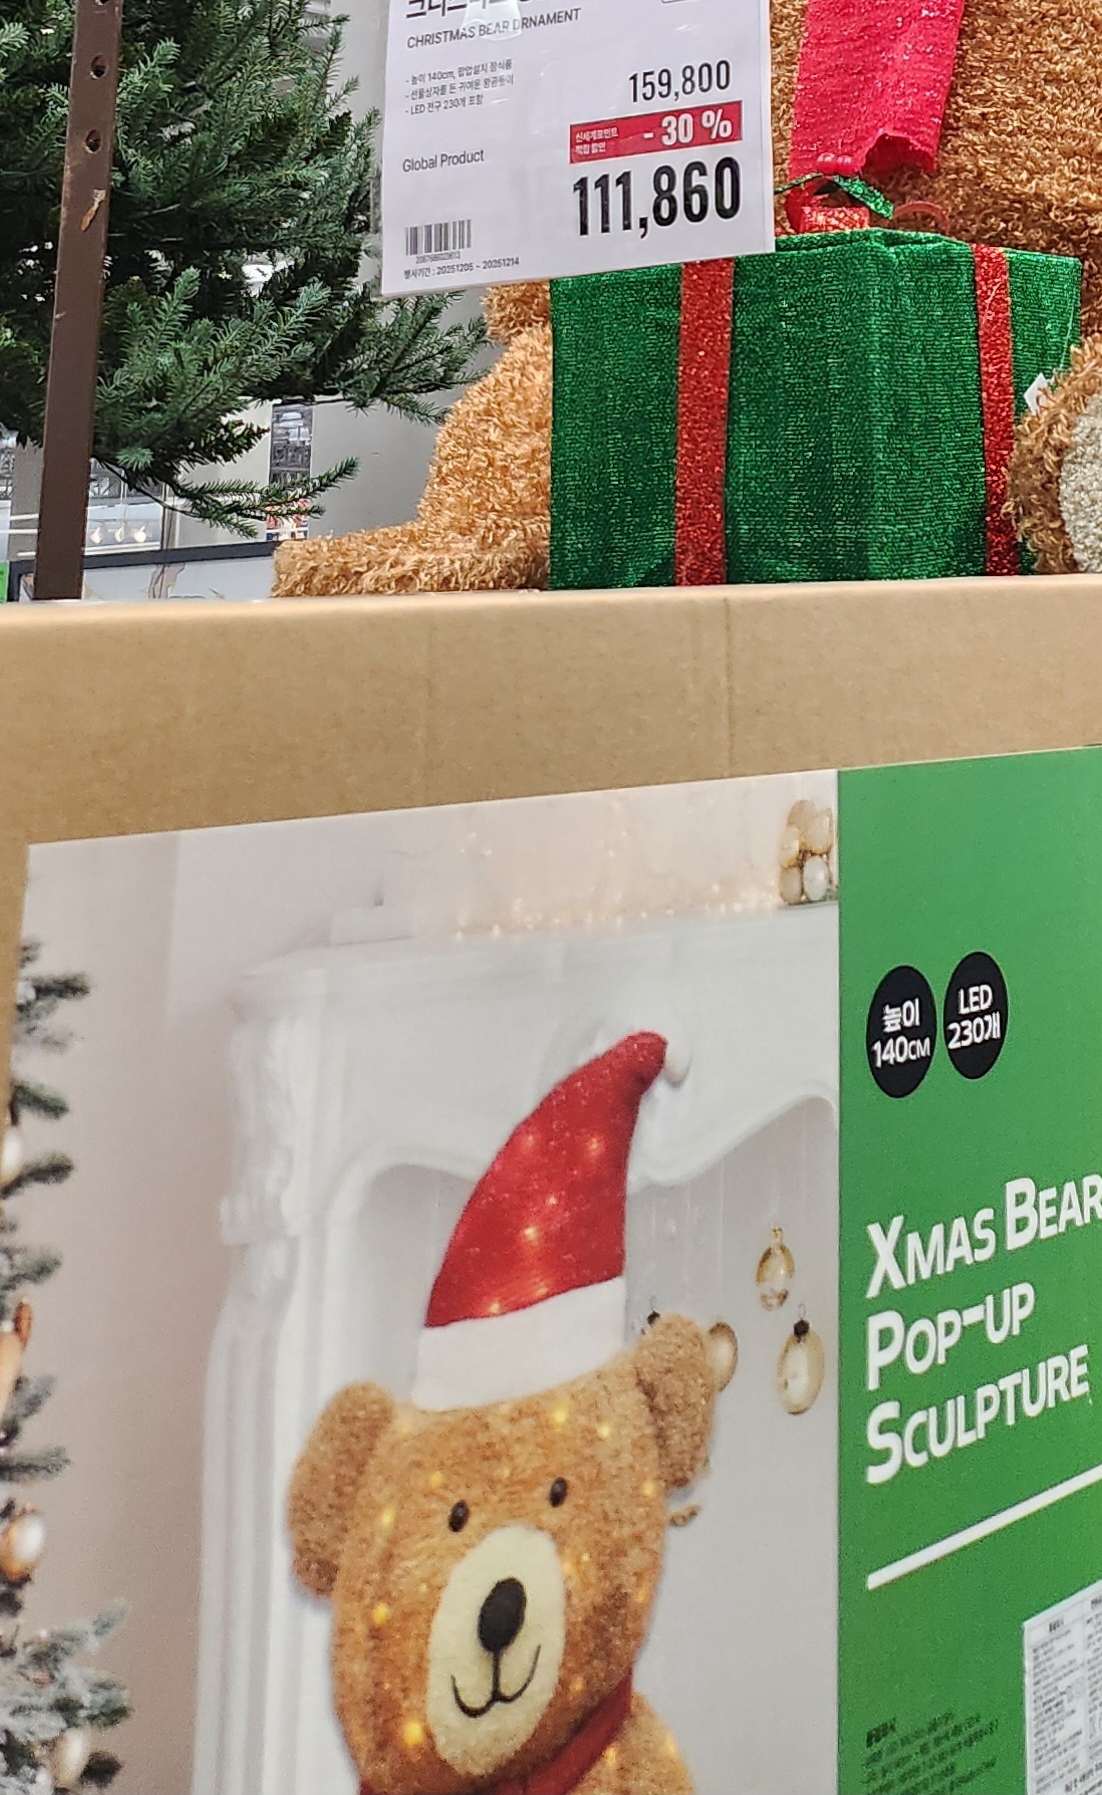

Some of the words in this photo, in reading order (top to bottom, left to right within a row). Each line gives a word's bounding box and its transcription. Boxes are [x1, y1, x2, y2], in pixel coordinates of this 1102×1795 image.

[407, 25, 476, 49] CHRISTMAS
[478, 19, 510, 38] BEAR
[628, 58, 732, 105] 159,800
[410, 103, 426, 116] LED
[660, 112, 694, 147] 30
[402, 153, 438, 174] Global
[440, 147, 485, 169] Product
[572, 156, 743, 240] 111,860
[881, 997, 921, 1034] 높이
[957, 983, 994, 1016] LED
[946, 1010, 1002, 1051] 230개
